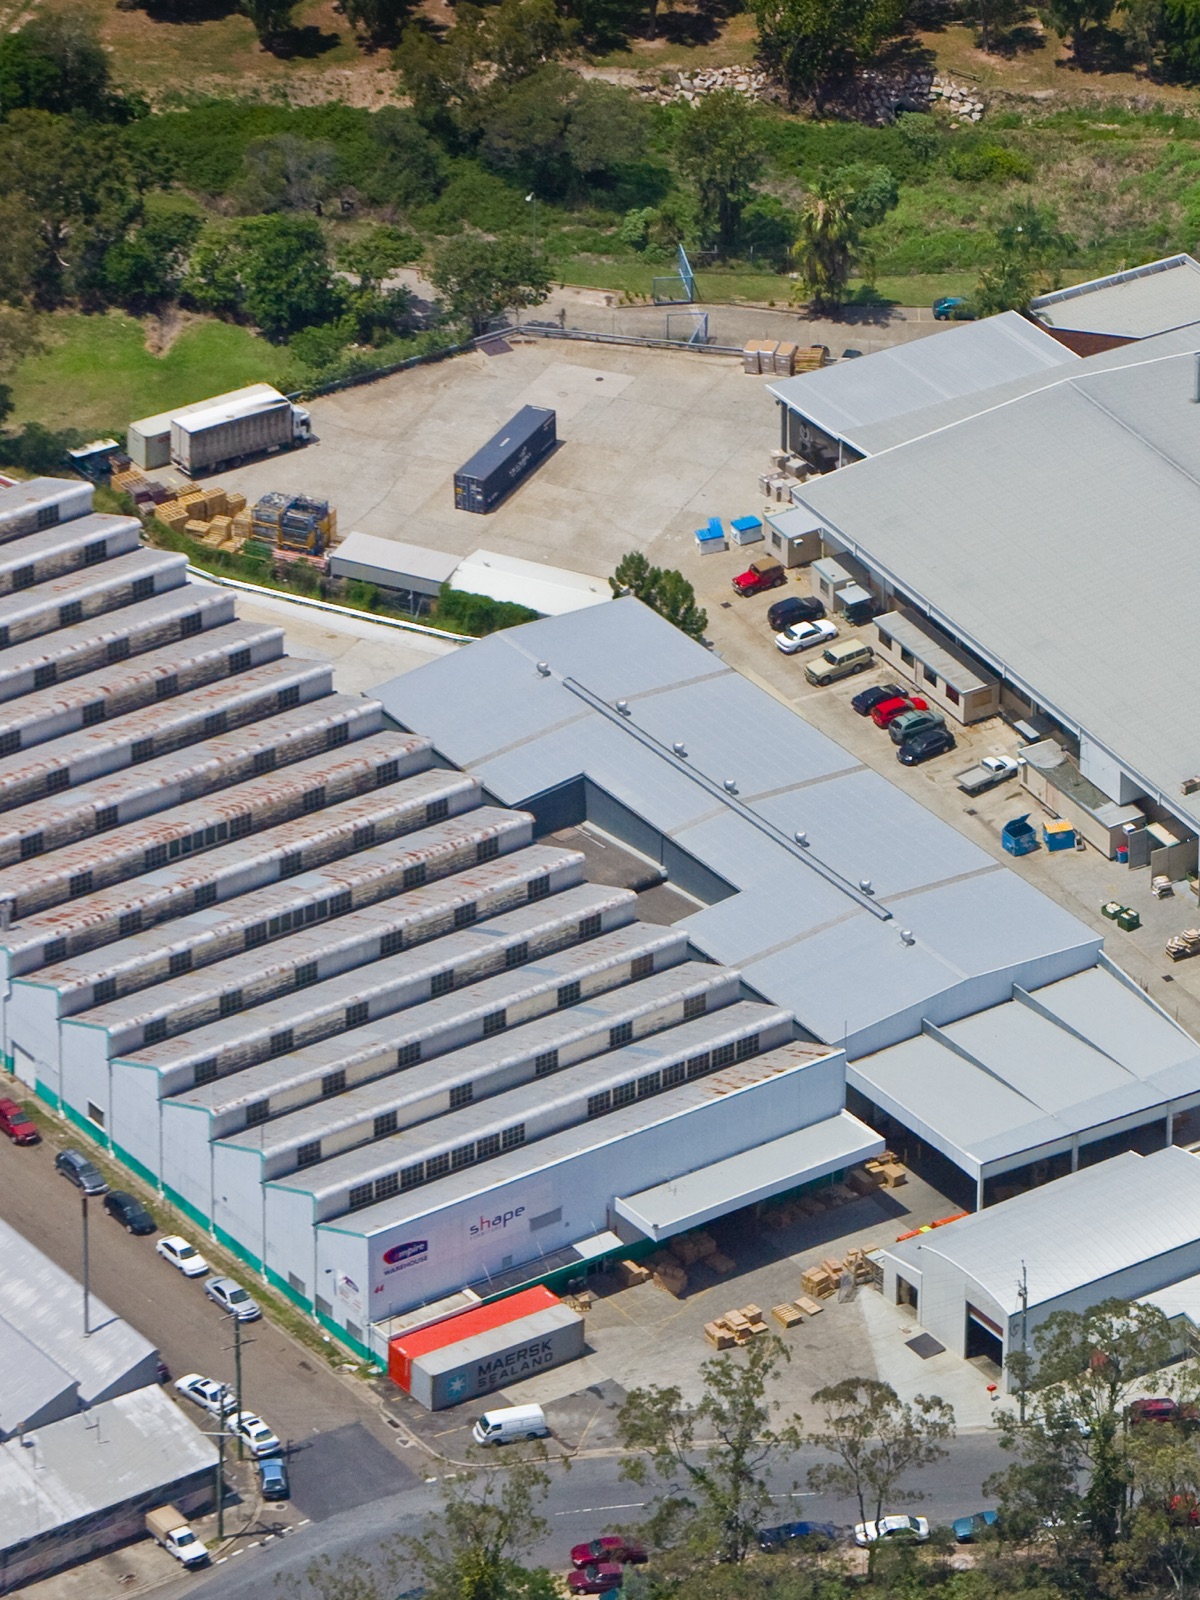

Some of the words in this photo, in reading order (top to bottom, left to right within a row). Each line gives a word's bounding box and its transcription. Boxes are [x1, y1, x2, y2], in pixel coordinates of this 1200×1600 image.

[470, 1206, 525, 1236] shape
[383, 1255, 428, 1276] WAREHOUSE
[477, 1338, 553, 1377] MAERSK
[478, 1351, 554, 1389] SEALAND
